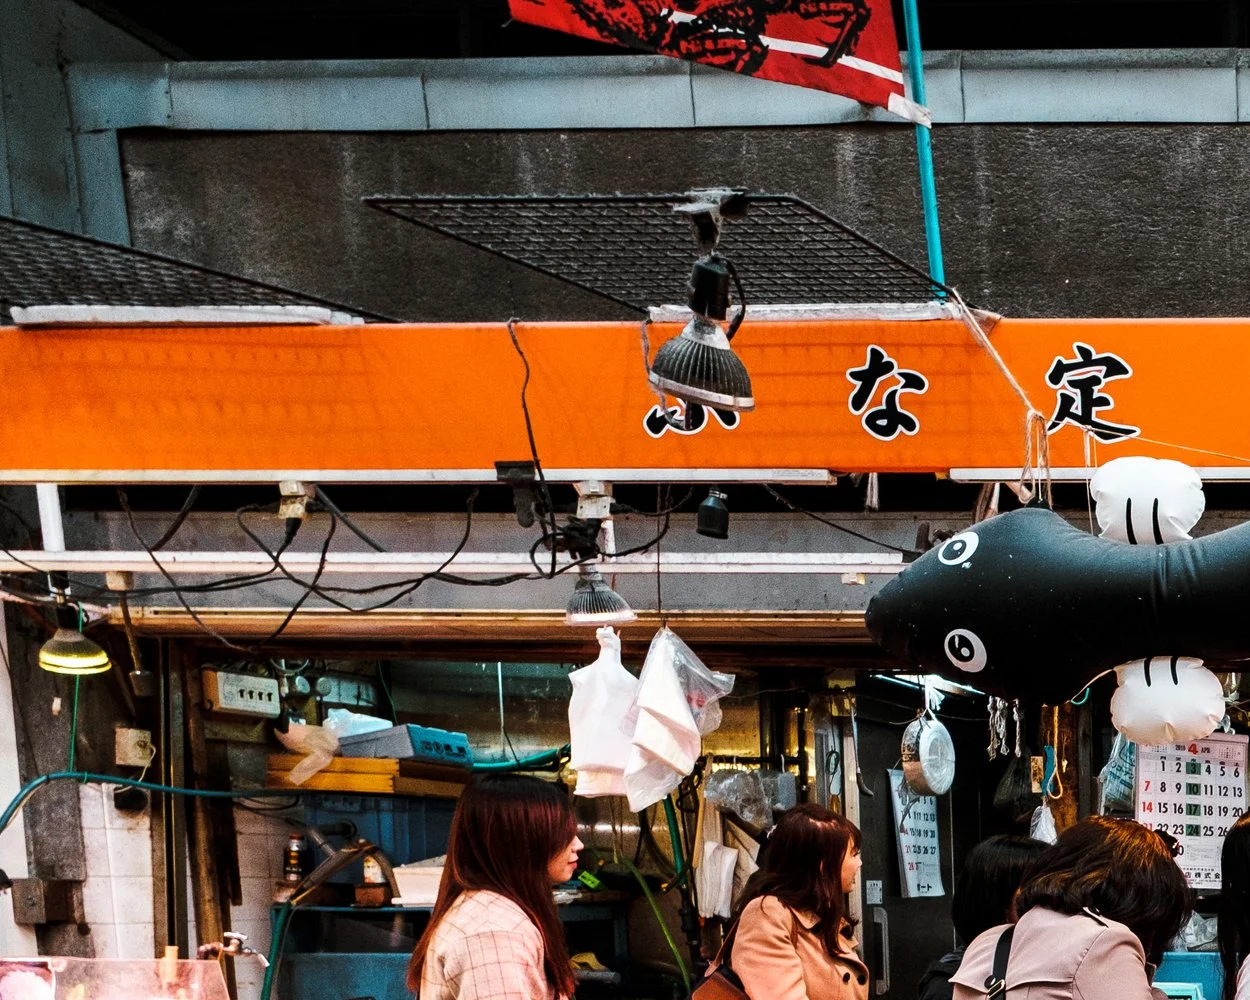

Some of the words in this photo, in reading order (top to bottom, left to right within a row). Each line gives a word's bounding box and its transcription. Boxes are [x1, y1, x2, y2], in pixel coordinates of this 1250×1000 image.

[1188, 743, 1199, 755] 4
[1176, 762, 1182, 773] 2
[1205, 764, 1211, 775] 4
[1220, 766, 1226, 776] 5
[1234, 767, 1240, 778] 6
[1144, 781, 1150, 792] 7
[1160, 782, 1166, 792] 8
[1176, 783, 1182, 794] 9
[1204, 785, 1213, 796] 11
[1218, 786, 1228, 797] 12
[1232, 787, 1242, 798] 13
[1142, 802, 1152, 812] 14
[1158, 803, 1168, 814] 15
[1173, 804, 1184, 814] 16
[1204, 805, 1214, 816] 18
[1218, 806, 1228, 817] 19
[1232, 807, 1244, 818] 20
[1203, 826, 1214, 837] 25
